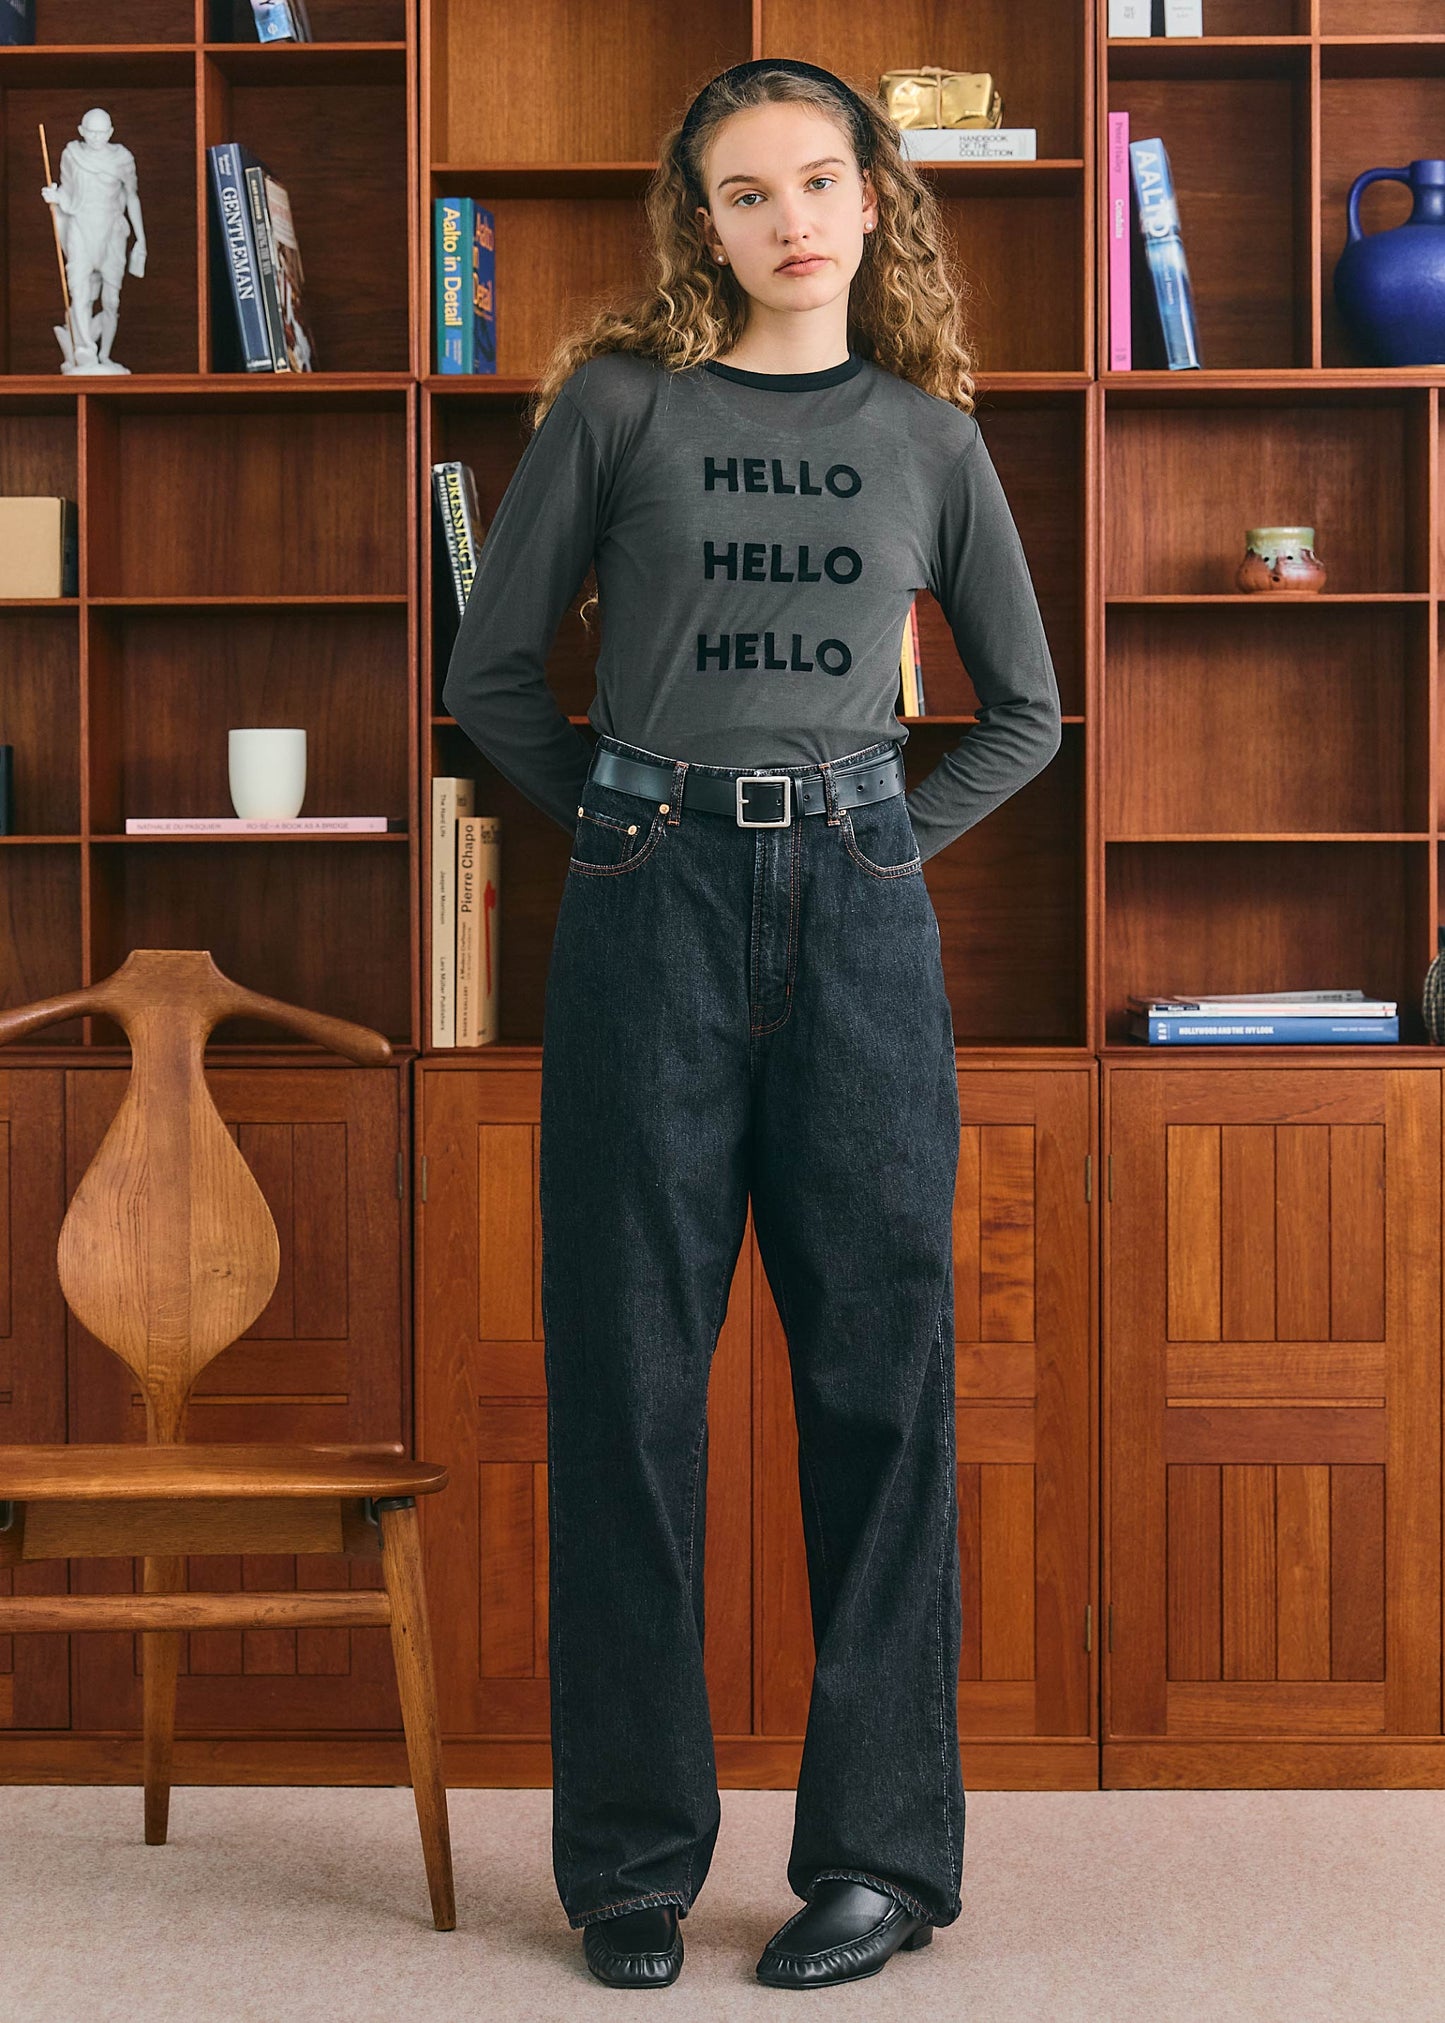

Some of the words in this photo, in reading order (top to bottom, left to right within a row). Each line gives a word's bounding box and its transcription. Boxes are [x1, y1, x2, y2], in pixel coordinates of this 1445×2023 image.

[960, 149, 1013, 157] COLLECTION
[1136, 151, 1170, 237] AALTO
[222, 187, 255, 300] GENTLEMAN
[443, 207, 461, 253] Aalto
[444, 256, 461, 272] in
[444, 277, 463, 326] Detail
[438, 475, 451, 520] MASTERING
[704, 457, 862, 498] HELLO
[445, 523, 456, 538] THE
[446, 474, 470, 562] DRESSING
[461, 569, 474, 601] TH
[448, 539, 458, 554] ART
[451, 556, 460, 567] OF
[704, 541, 863, 584] HELLO
[696, 632, 852, 676] HELLO
[461, 824, 476, 868] Chapo
[461, 872, 473, 913] Pierre
[1178, 1027, 1217, 1035] HOLLYWOOD
[1218, 1027, 1232, 1035] AND
[1257, 1026, 1274, 1034] LOOK
